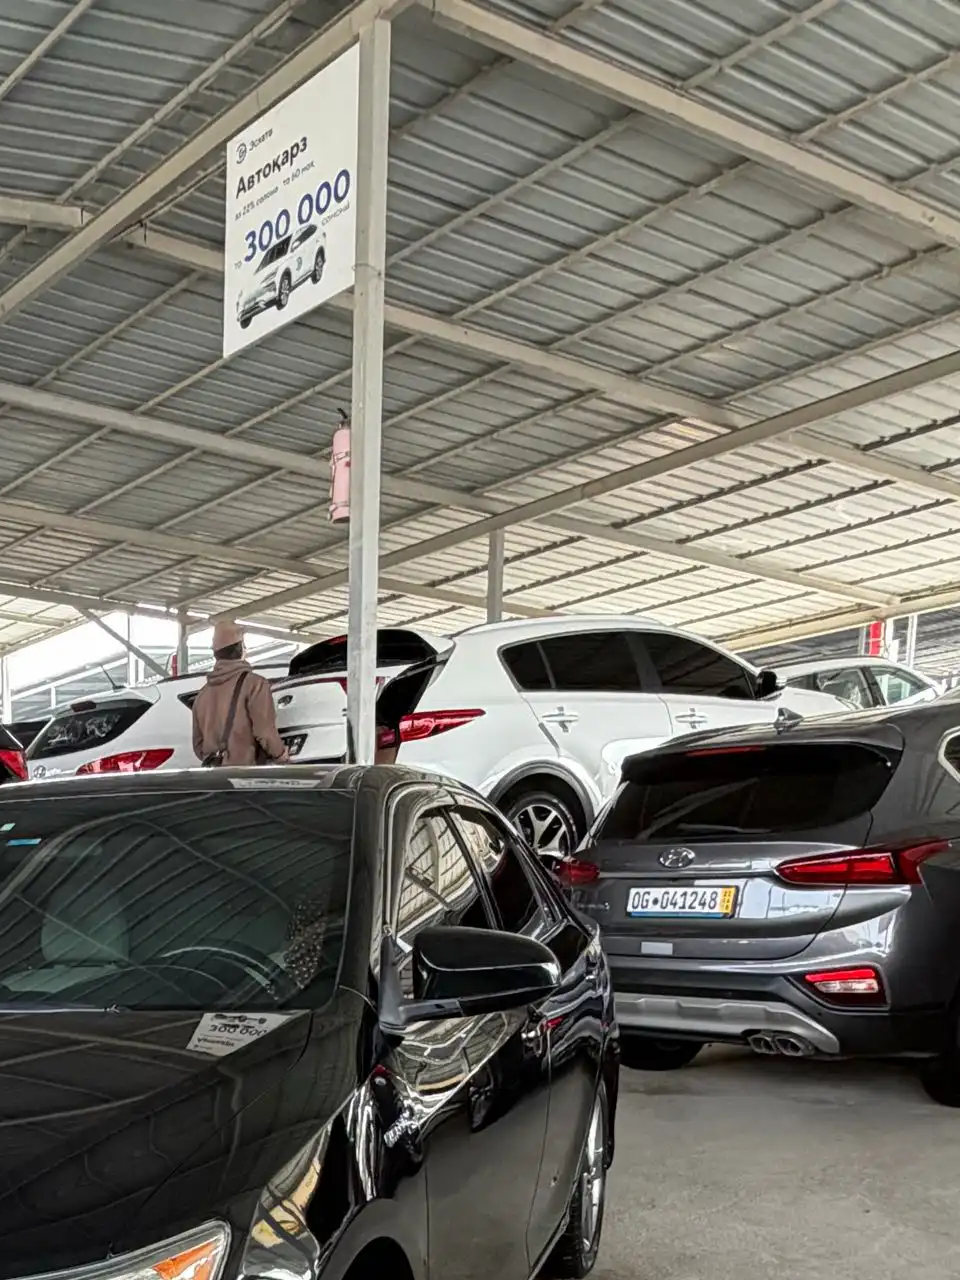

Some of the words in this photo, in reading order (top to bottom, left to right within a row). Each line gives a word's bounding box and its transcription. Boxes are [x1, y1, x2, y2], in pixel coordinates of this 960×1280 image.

[236, 136, 307, 199] Автоқарз
[244, 209, 291, 262] 300
[297, 169, 350, 225] 000
